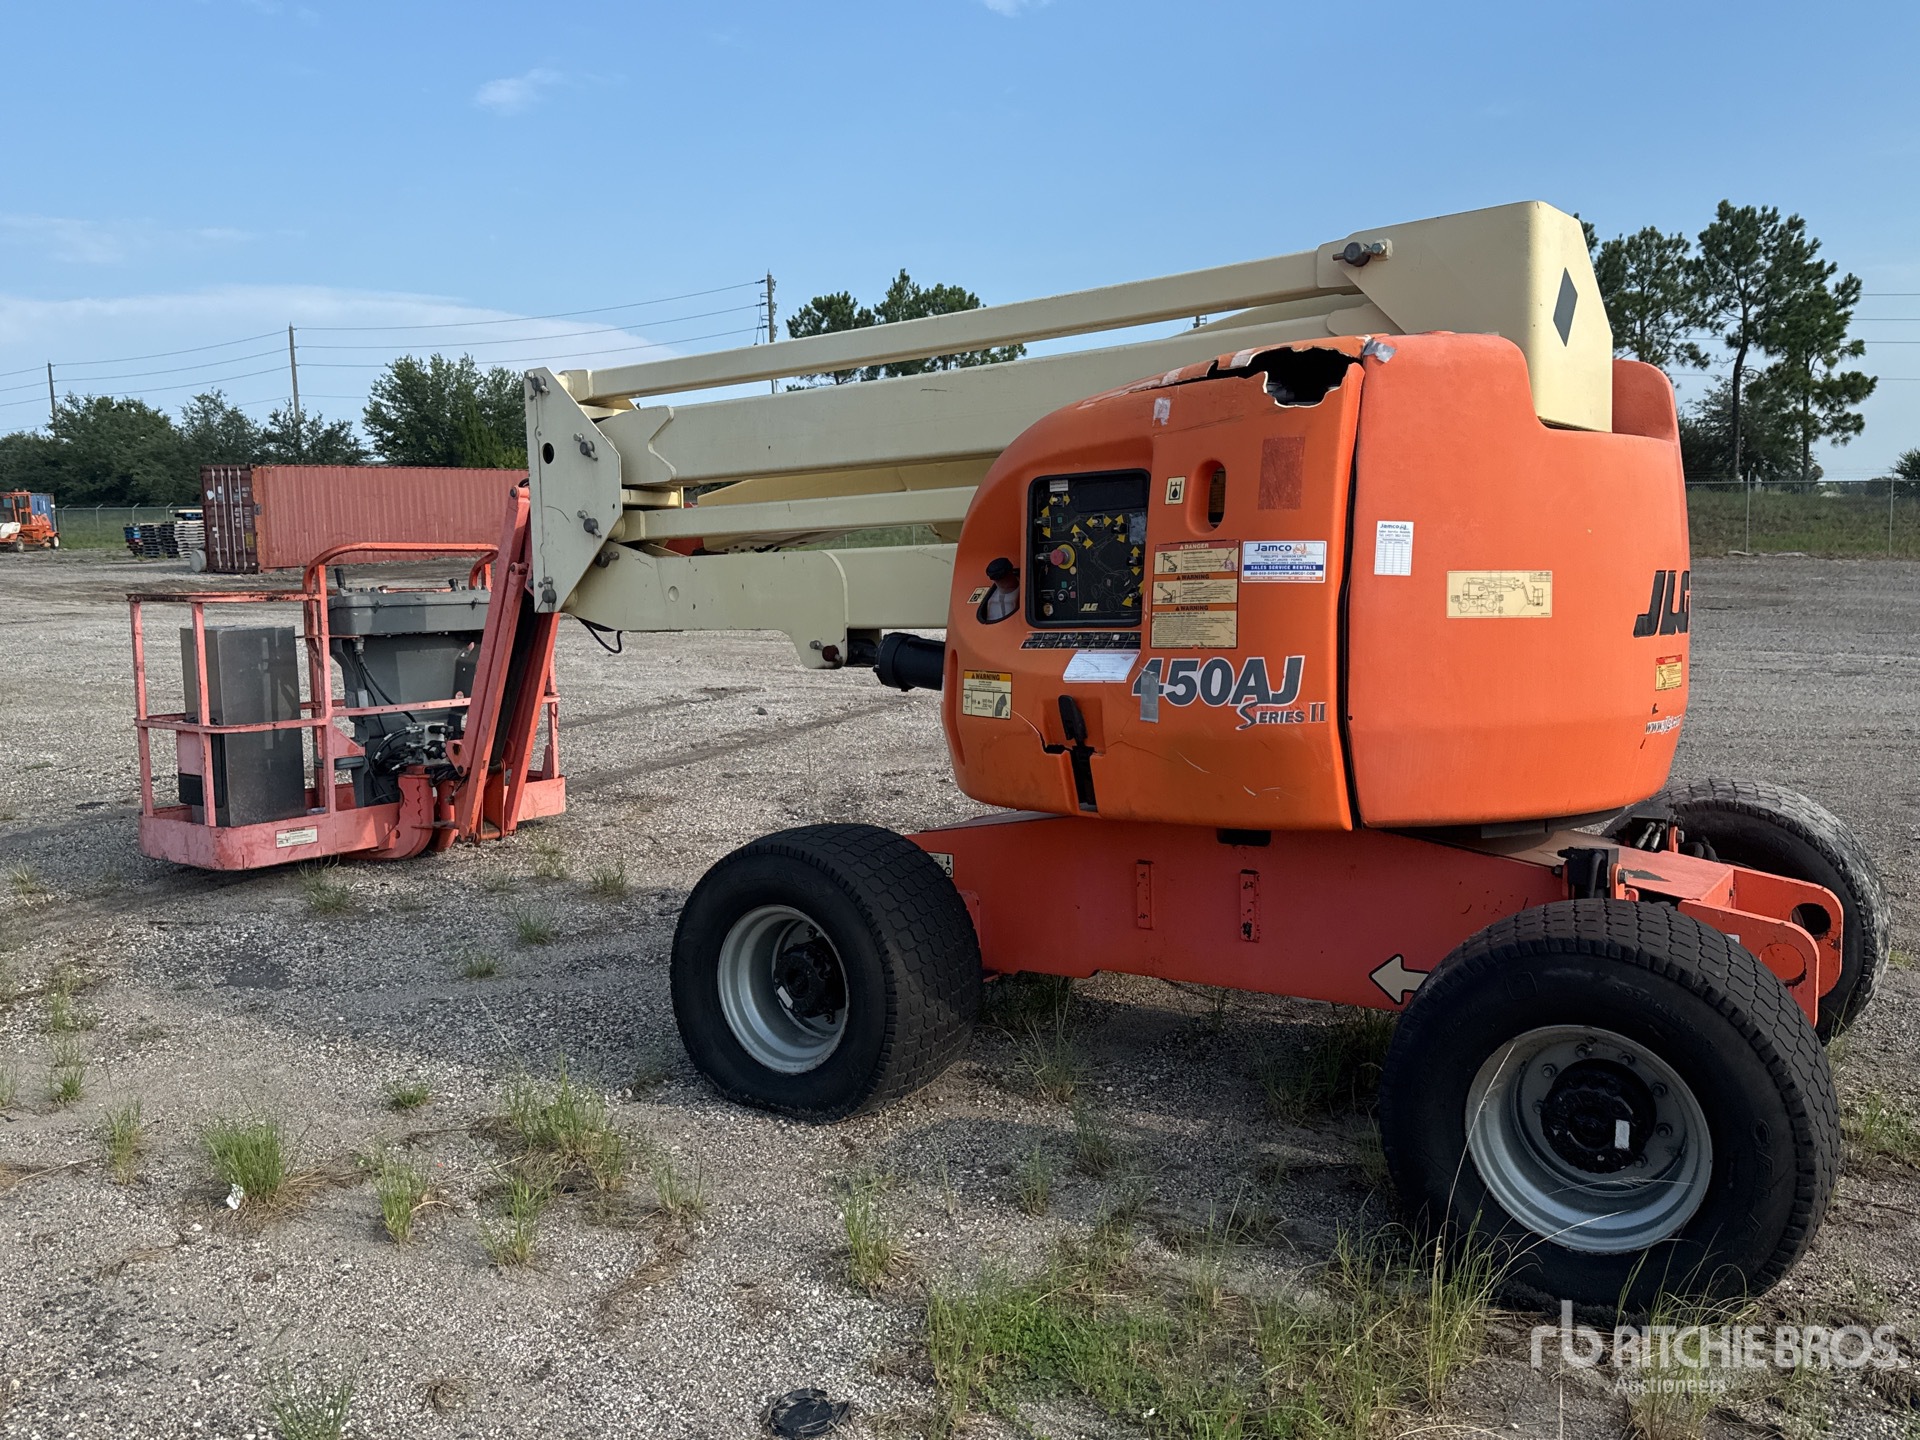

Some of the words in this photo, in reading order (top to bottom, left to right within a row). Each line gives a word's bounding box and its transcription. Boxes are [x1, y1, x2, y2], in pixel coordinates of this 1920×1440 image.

[1254, 543, 1292, 552] Jamco
[1080, 603, 1099, 612] JLG
[975, 673, 1000, 681] WARNING
[1132, 655, 1306, 708] 450AJ
